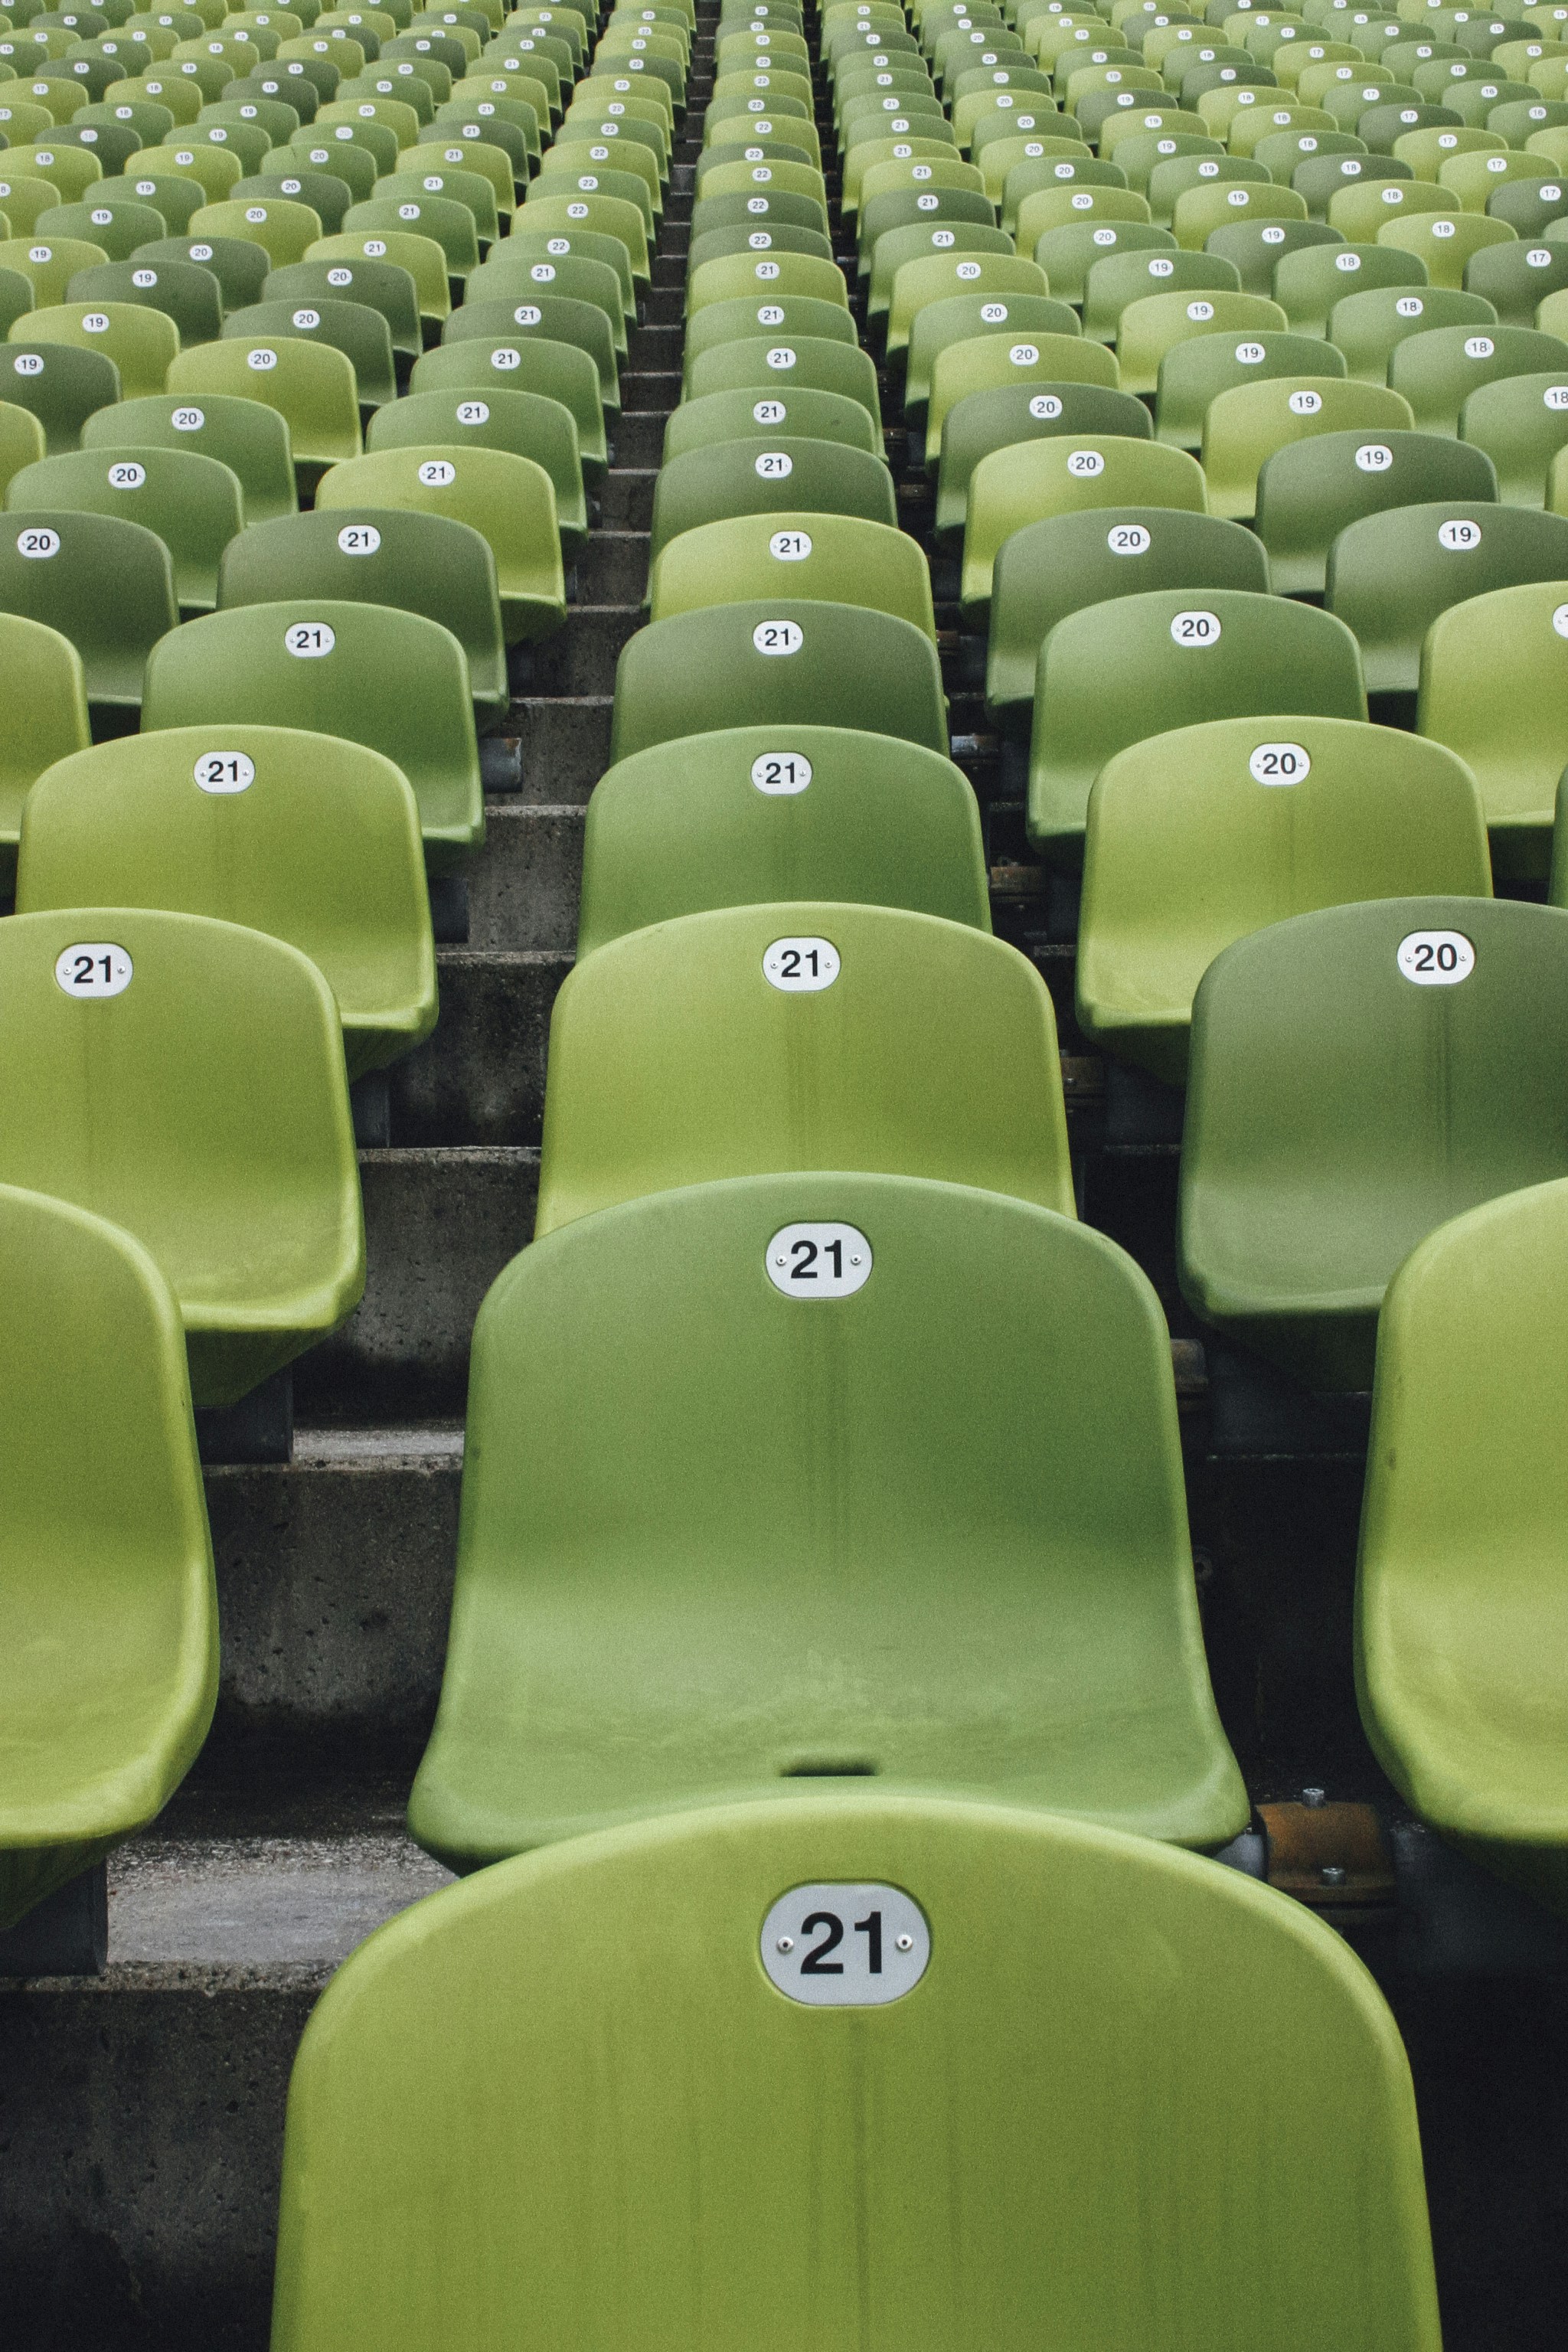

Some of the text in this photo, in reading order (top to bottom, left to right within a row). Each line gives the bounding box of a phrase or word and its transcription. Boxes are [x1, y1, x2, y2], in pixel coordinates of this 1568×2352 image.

[1545, 187, 1558, 197] 17
[753, 201, 765, 209] 22
[1076, 197, 1089, 205] 20
[754, 236, 767, 244] 22
[937, 234, 949, 243] 21
[1099, 233, 1112, 241] 20
[1268, 230, 1280, 239] 19
[369, 243, 380, 253] 21
[553, 242, 565, 250] 22
[35, 250, 47, 258] 19
[194, 248, 207, 256] 20
[1533, 253, 1546, 262] 17
[1342, 257, 1355, 266] 18
[537, 268, 549, 277] 21
[761, 266, 773, 275] 21
[962, 266, 976, 275] 20
[1155, 263, 1169, 272] 19
[139, 273, 152, 283] 19
[333, 272, 348, 281] 20
[987, 307, 1001, 317] 20
[1194, 305, 1208, 315] 19
[1403, 302, 1417, 312] 18
[299, 314, 314, 324] 20
[521, 310, 534, 320] 21
[764, 310, 777, 320] 21
[90, 317, 103, 327] 19
[1472, 341, 1488, 352] 18
[498, 353, 512, 364] 21
[774, 352, 788, 363] 21
[1016, 349, 1033, 360] 20
[1243, 348, 1259, 358] 19
[21, 359, 37, 370] 19
[254, 354, 270, 364] 20
[1298, 396, 1315, 408] 19
[1551, 391, 1568, 403] 18
[761, 406, 776, 418] 21
[1037, 401, 1055, 413] 20
[179, 413, 198, 424] 20
[464, 407, 480, 419] 21
[1076, 456, 1096, 469] 20
[1365, 451, 1384, 464] 19
[764, 459, 782, 472] 21
[116, 468, 137, 482] 20
[427, 466, 445, 479] 21
[348, 532, 368, 547] 21
[1118, 531, 1141, 547] 20
[1449, 527, 1472, 542] 19
[27, 535, 51, 550] 20
[780, 537, 800, 553] 21
[1182, 619, 1210, 637] 20
[296, 630, 320, 648] 21
[765, 629, 789, 646] 21
[1263, 753, 1296, 774] 20
[208, 760, 237, 782] 21
[766, 762, 795, 784] 21
[782, 949, 818, 977] 21
[1415, 943, 1457, 972] 20
[74, 956, 111, 983] 21
[791, 1240, 841, 1279] 21
[800, 1912, 882, 1975] 21
